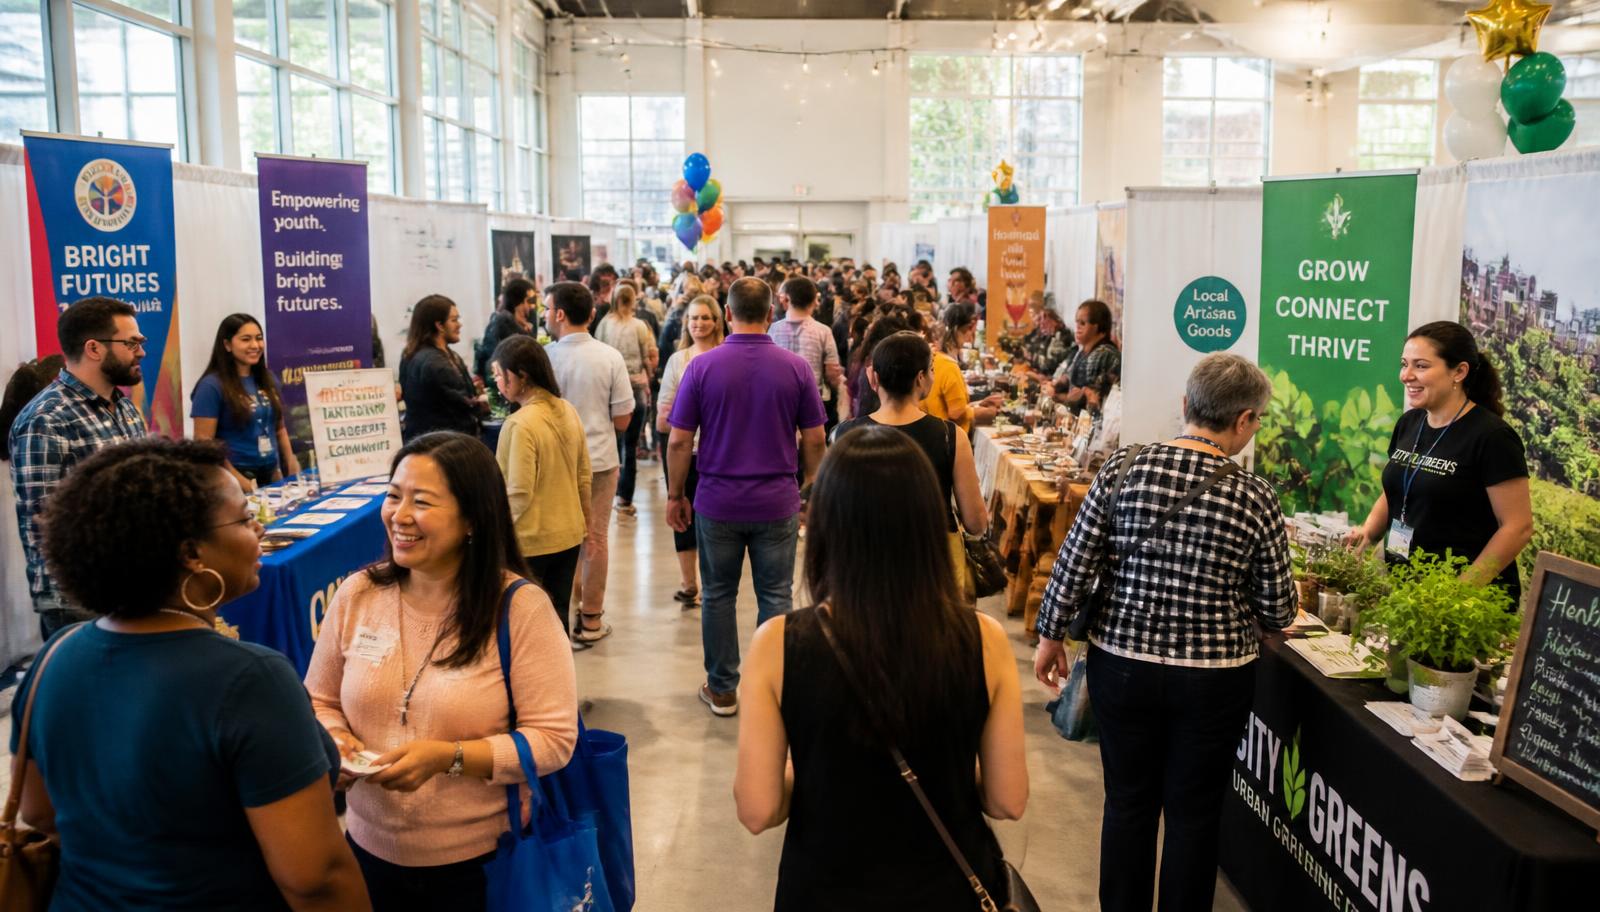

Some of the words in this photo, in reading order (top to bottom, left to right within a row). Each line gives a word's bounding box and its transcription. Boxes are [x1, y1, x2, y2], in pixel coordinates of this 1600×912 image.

[271, 190, 360, 212] Empowering
[64, 244, 151, 268] BRIGHT
[1298, 259, 1370, 282] GROW
[61, 272, 160, 296] FUTURES
[276, 272, 326, 294] bright
[277, 295, 343, 312] futures.
[1193, 288, 1229, 302] Local
[1275, 296, 1389, 322] CONNECT
[1187, 323, 1232, 338] Goods
[1287, 334, 1371, 362] THRIVE
[1233, 769, 1269, 827] URBAN
[1308, 772, 1430, 912] GREENS
